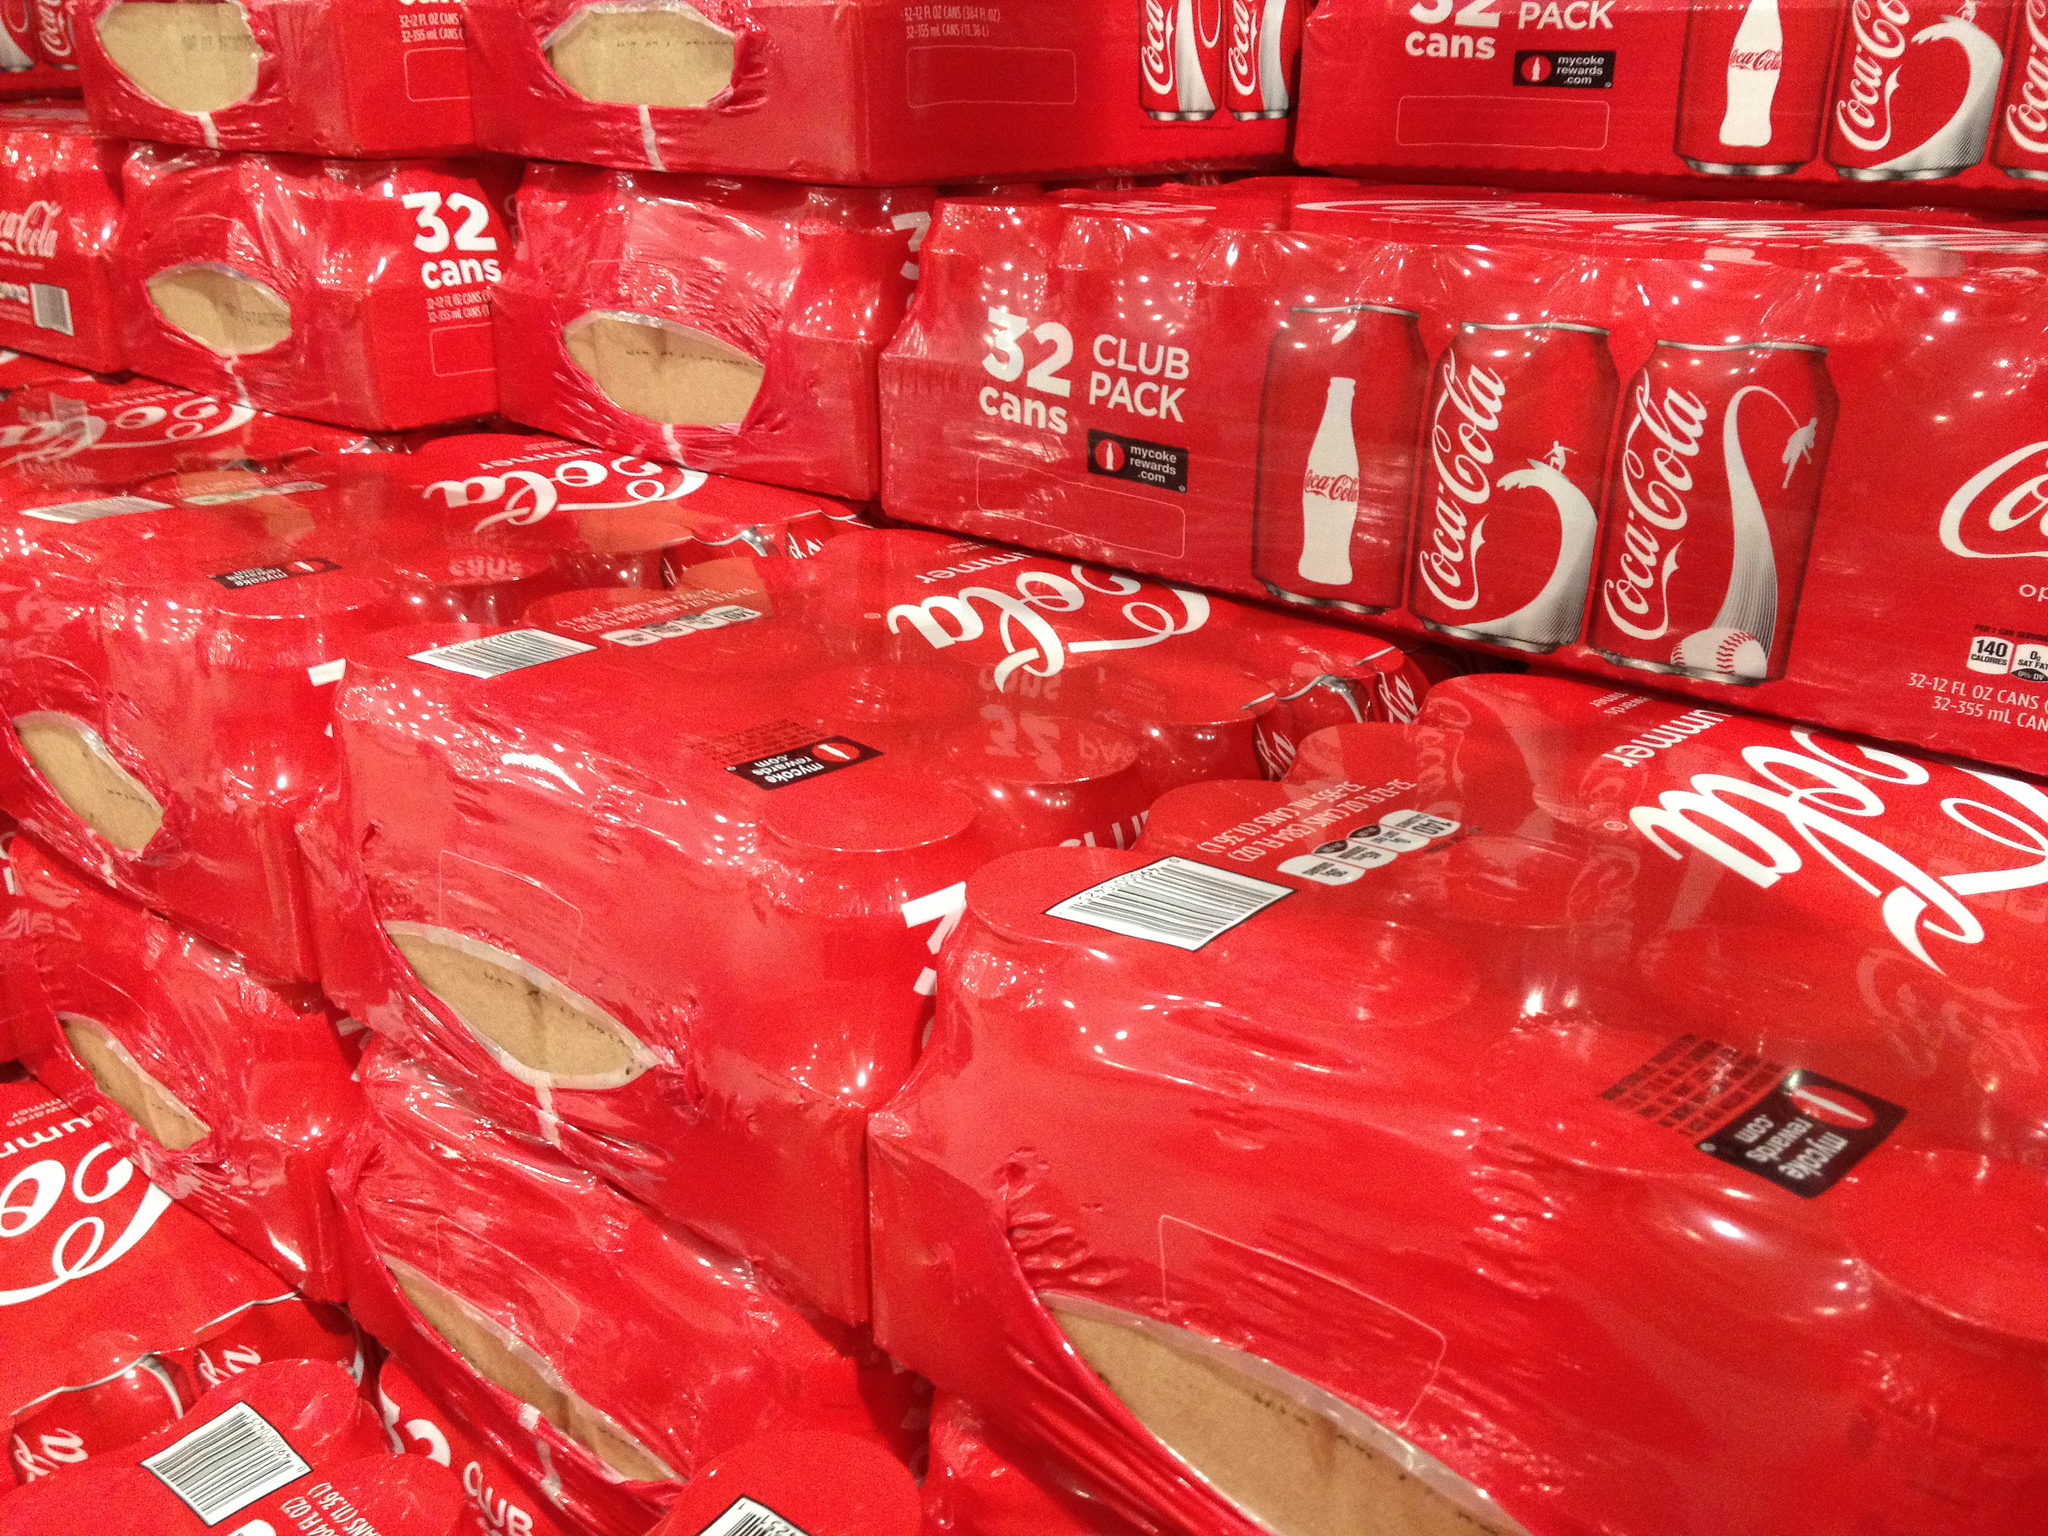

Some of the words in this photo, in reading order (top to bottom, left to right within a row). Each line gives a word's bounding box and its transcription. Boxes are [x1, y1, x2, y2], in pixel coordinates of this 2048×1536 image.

[1518, 0, 1614, 30] PACK
[1404, 31, 1496, 59] cans
[1556, 66, 1603, 76] rewards
[1558, 55, 1605, 68] mycoke
[1564, 76, 1592, 85] .com
[401, 191, 498, 253] 32
[421, 258, 502, 290] cans
[982, 306, 1073, 398] 32
[1093, 334, 1190, 380] CLUB
[1089, 371, 1186, 423] PACK
[979, 386, 1068, 434] cans
[1130, 446, 1177, 463] mycoke
[1130, 457, 1176, 475] rewards
[1138, 470, 1165, 483] .com
[1419, 348, 1508, 610] Coca-Cola
[1603, 367, 1708, 640] Coca-Cola
[1976, 639, 2008, 657] 140
[1970, 653, 2007, 666] CALORIES
[2018, 658, 2033, 668] SAT
[1908, 671, 1949, 693] 32-12
[1951, 681, 1967, 696] FL
[1972, 684, 1994, 700] OZ
[1997, 688, 2040, 711] CANS
[1932, 695, 1984, 717] 32-355
[1988, 707, 2012, 724] mL
[2017, 712, 2048, 732] CAN
[1602, 709, 1733, 768] ummer
[752, 755, 813, 776] rewards
[754, 754, 789, 768] .com
[764, 762, 824, 783] mycoke
[1355, 794, 1386, 803] FL
[1375, 779, 1417, 798] 32-12
[1253, 807, 1300, 826] CANS
[1337, 801, 1369, 812] OZ
[1301, 809, 1350, 827] CANS
[1213, 823, 1266, 845] (11.36
[1252, 838, 1285, 848] FL
[1271, 824, 1316, 842] (384
[1228, 846, 1266, 861] OZ)
[1733, 1114, 1774, 1144] .com
[1745, 1116, 1813, 1162] rewards
[1777, 1131, 1849, 1180] mycoke
[306, 1482, 333, 1498] L)
[280, 1496, 312, 1518] OZ)
[317, 1491, 359, 1523] (11.36
[297, 1511, 323, 1530] FL
